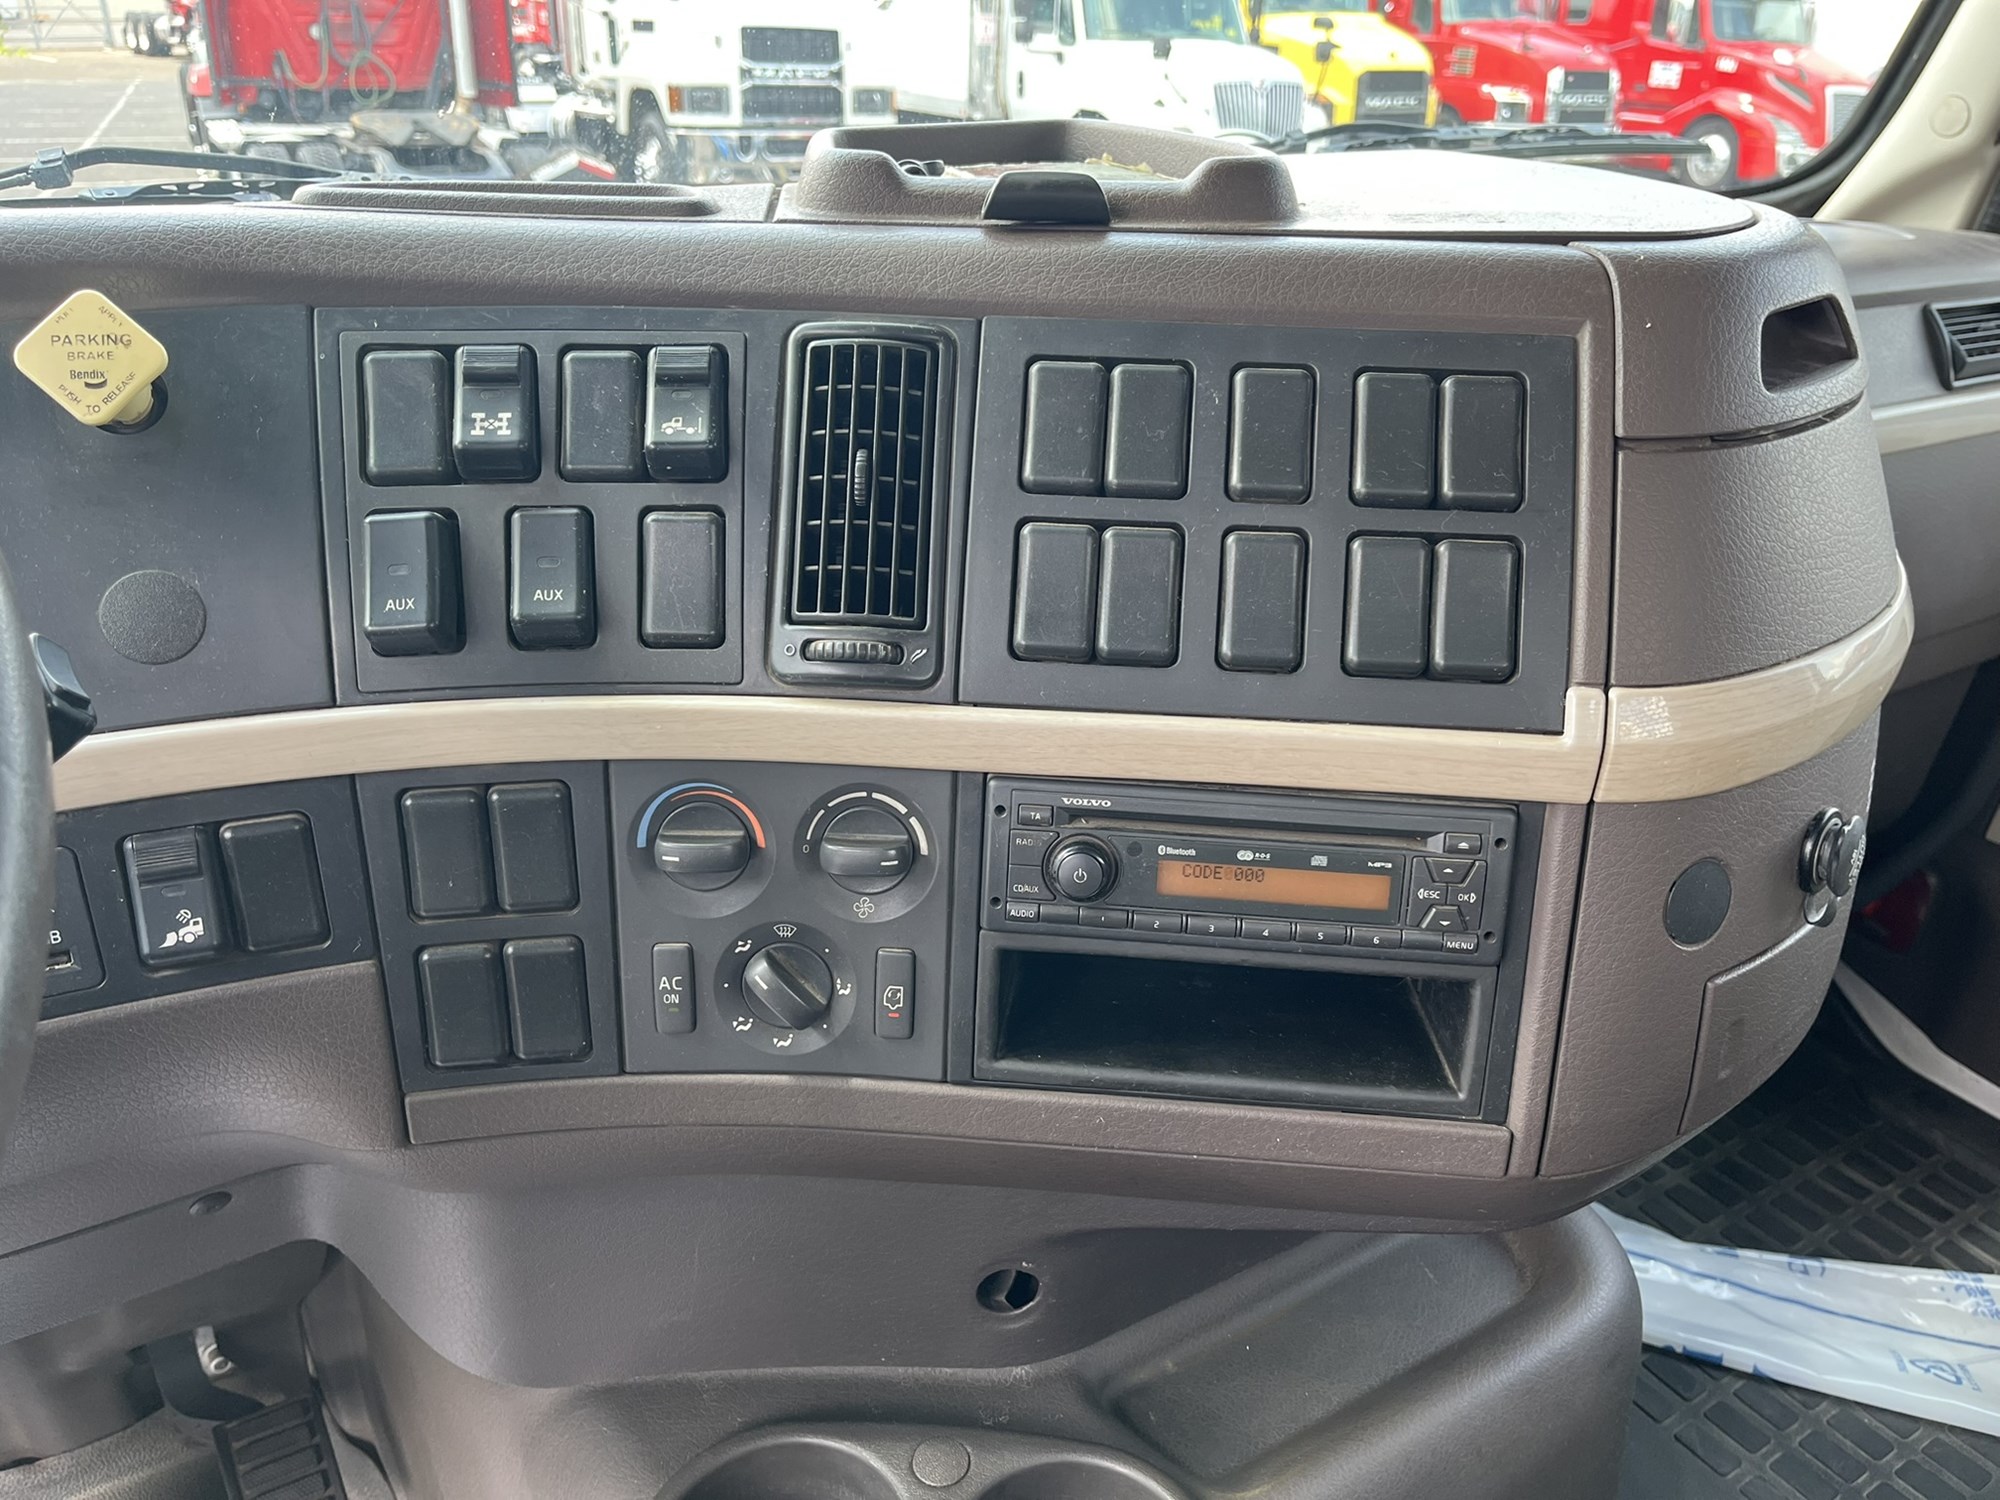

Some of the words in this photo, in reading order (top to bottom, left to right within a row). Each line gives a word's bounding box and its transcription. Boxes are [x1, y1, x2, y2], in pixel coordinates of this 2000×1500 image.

[50, 333, 132, 347] PARKING
[67, 351, 115, 361] BRAKE
[69, 369, 106, 380] Bendix
[58, 384, 82, 405] PUSH
[86, 404, 101, 414] TO
[101, 371, 137, 406] RELEASE
[533, 588, 564, 602] AUX
[384, 597, 416, 612] AUX
[1060, 796, 1112, 808] VOLVO
[1029, 812, 1041, 821] TA
[1166, 846, 1197, 857] Bluetooth
[1367, 861, 1393, 869] MP3
[1182, 863, 1224, 880] CODE
[1234, 866, 1265, 883] 000
[1423, 889, 1441, 900] ESC
[1457, 893, 1470, 902] OK
[1009, 908, 1035, 919] AUDIO
[1153, 920, 1160, 929] 2
[1207, 924, 1215, 933] 3
[1262, 928, 1269, 937] 4
[1317, 932, 1324, 941] 5
[1372, 936, 1380, 945] 6
[1446, 940, 1475, 951] MENU
[658, 976, 683, 991] AC
[663, 993, 680, 1004] ON
